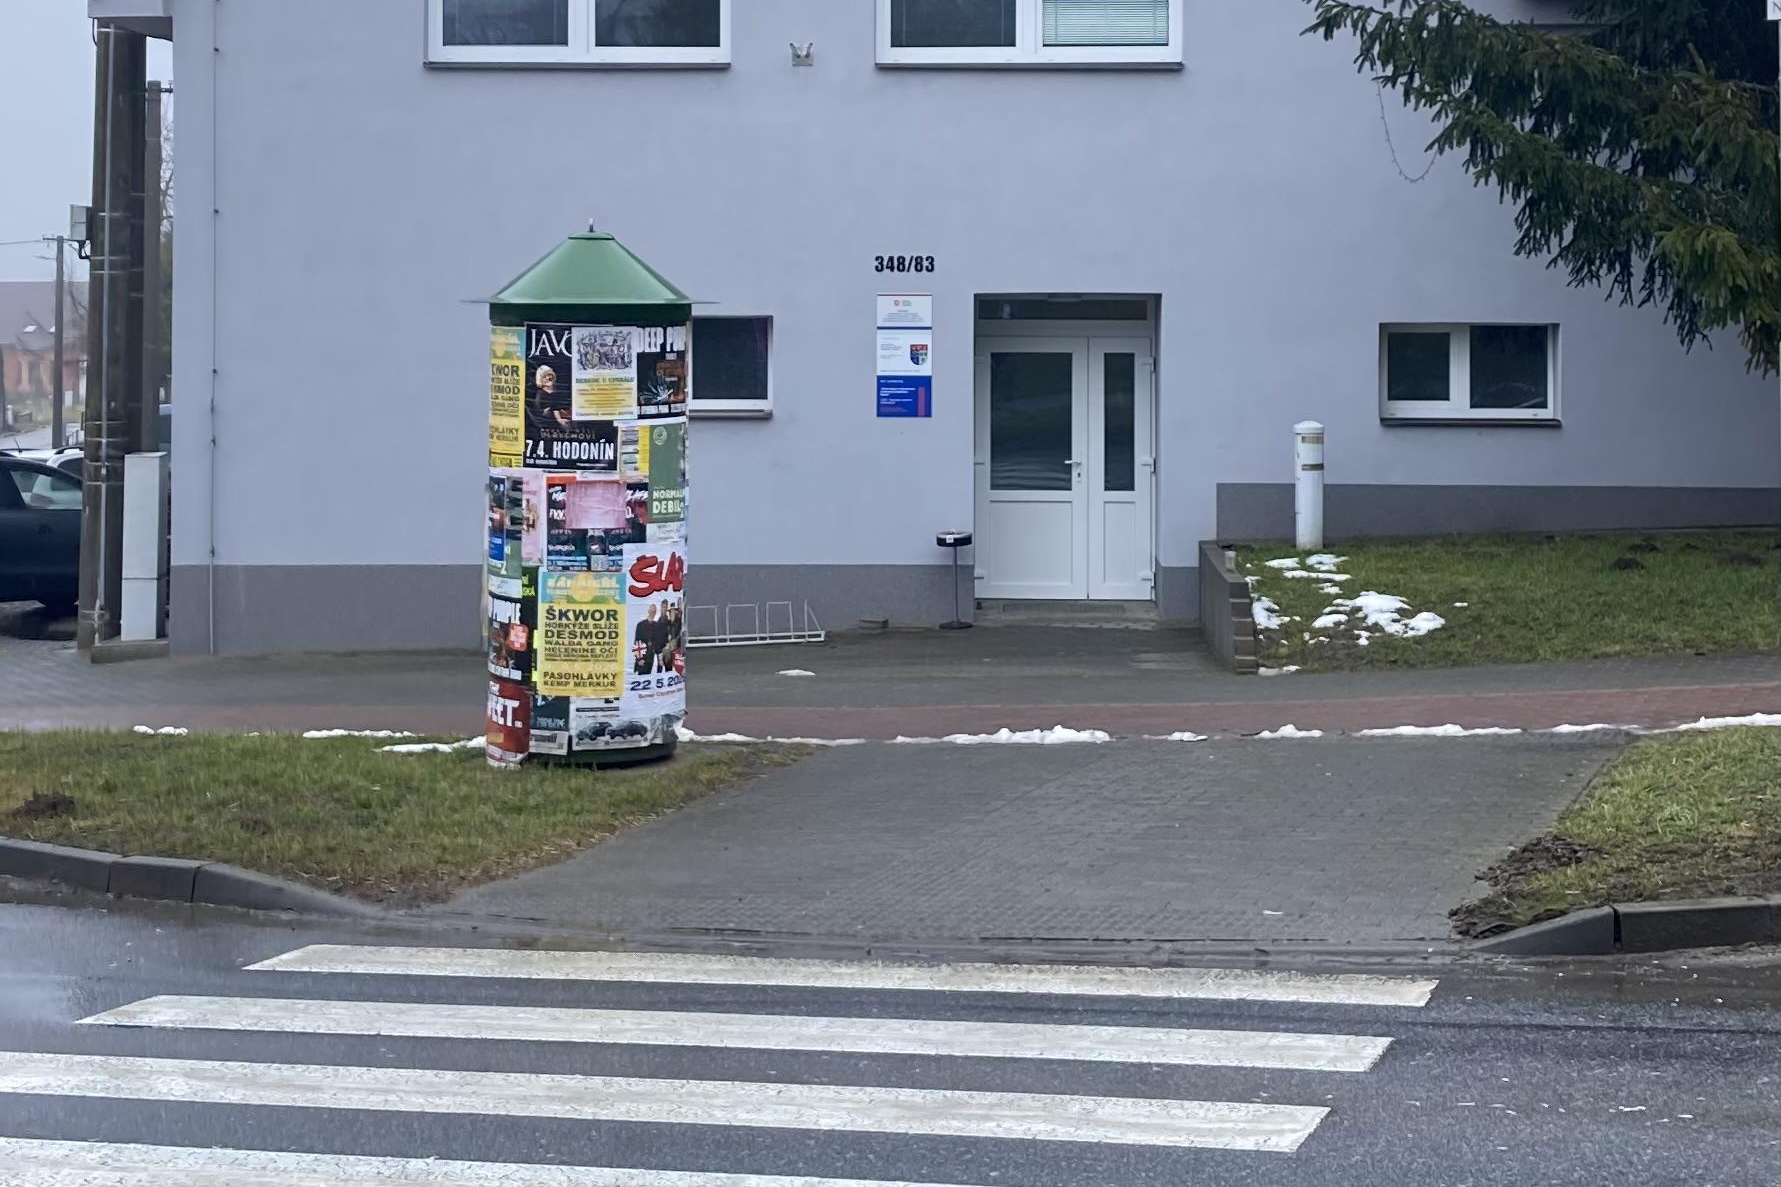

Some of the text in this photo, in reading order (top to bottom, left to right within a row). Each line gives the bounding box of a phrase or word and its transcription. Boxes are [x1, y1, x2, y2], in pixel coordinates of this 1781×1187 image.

[875, 255, 935, 273] 348/83
[526, 439, 614, 460] 7.4. HODONÍN
[545, 605, 618, 621] ŠKWOR
[545, 630, 618, 639] DESMOD
